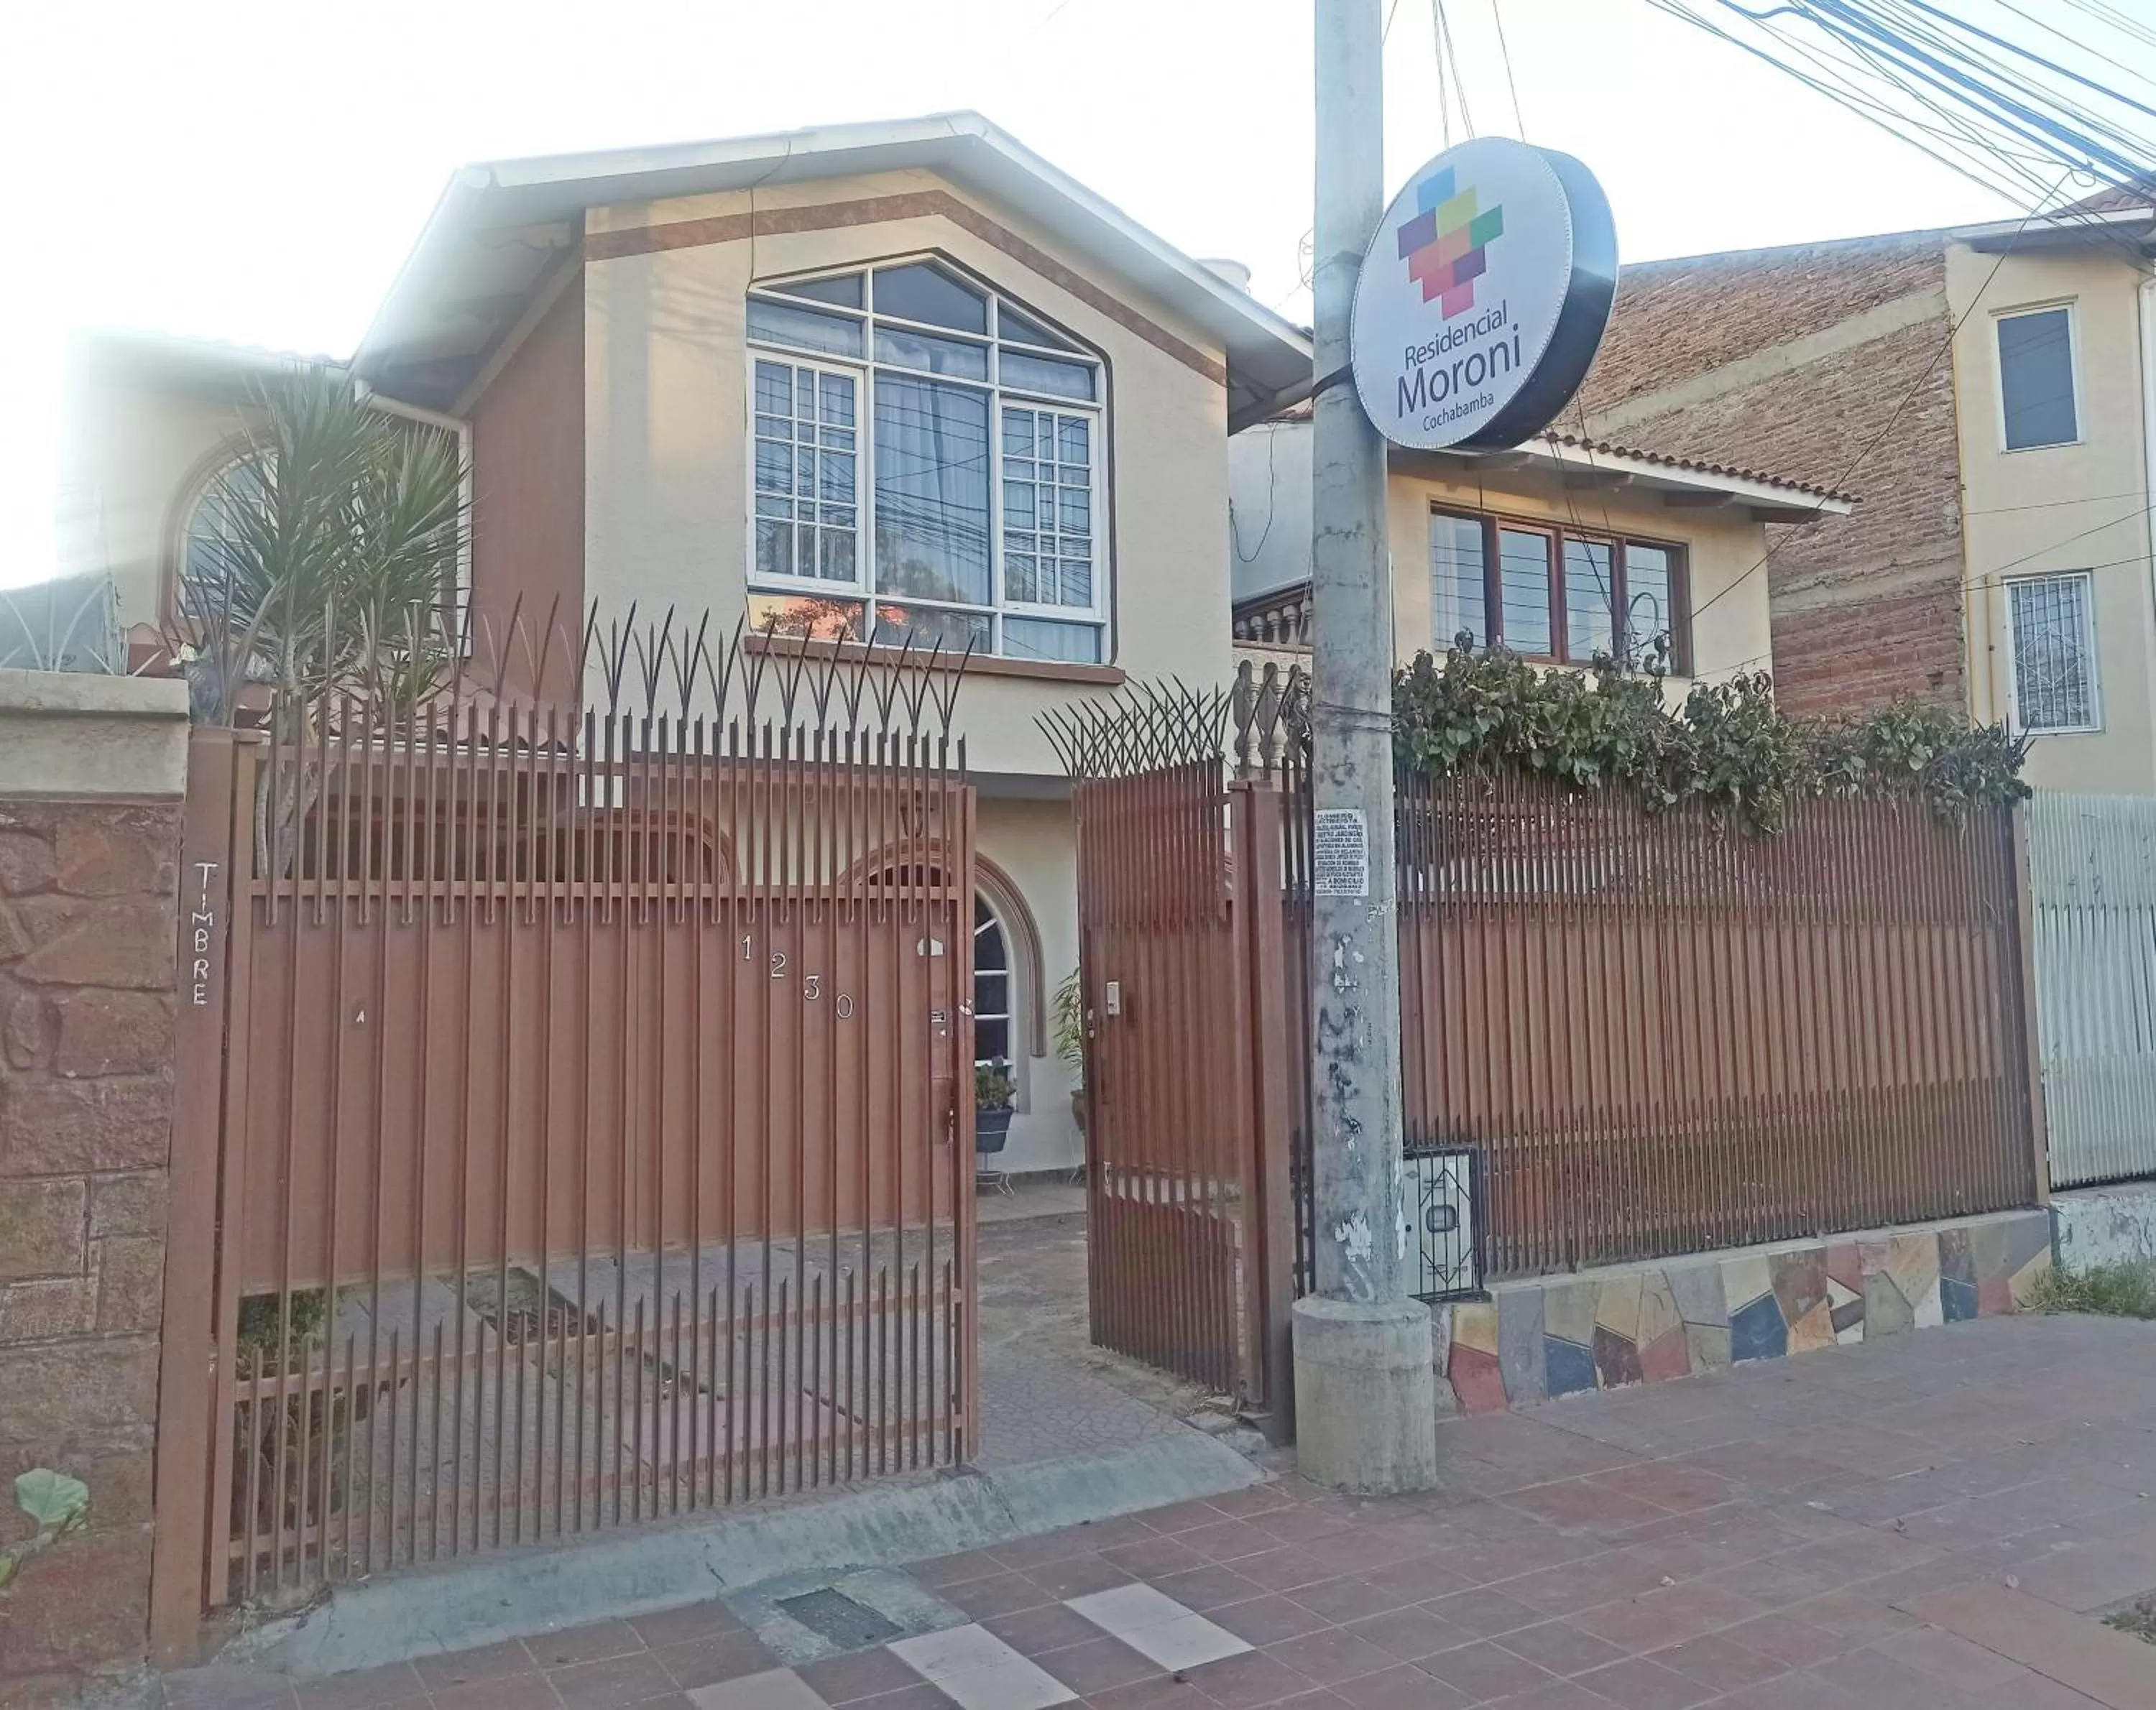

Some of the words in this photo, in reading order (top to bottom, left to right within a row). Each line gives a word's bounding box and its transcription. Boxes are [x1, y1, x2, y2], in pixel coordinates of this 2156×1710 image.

[1398, 323, 1520, 418] Moroni
[1405, 299, 1507, 370] Residencial
[1423, 392, 1494, 432] Cochabamba
[192, 862, 218, 1004] TIMBRE
[742, 935, 854, 1018] 1230
